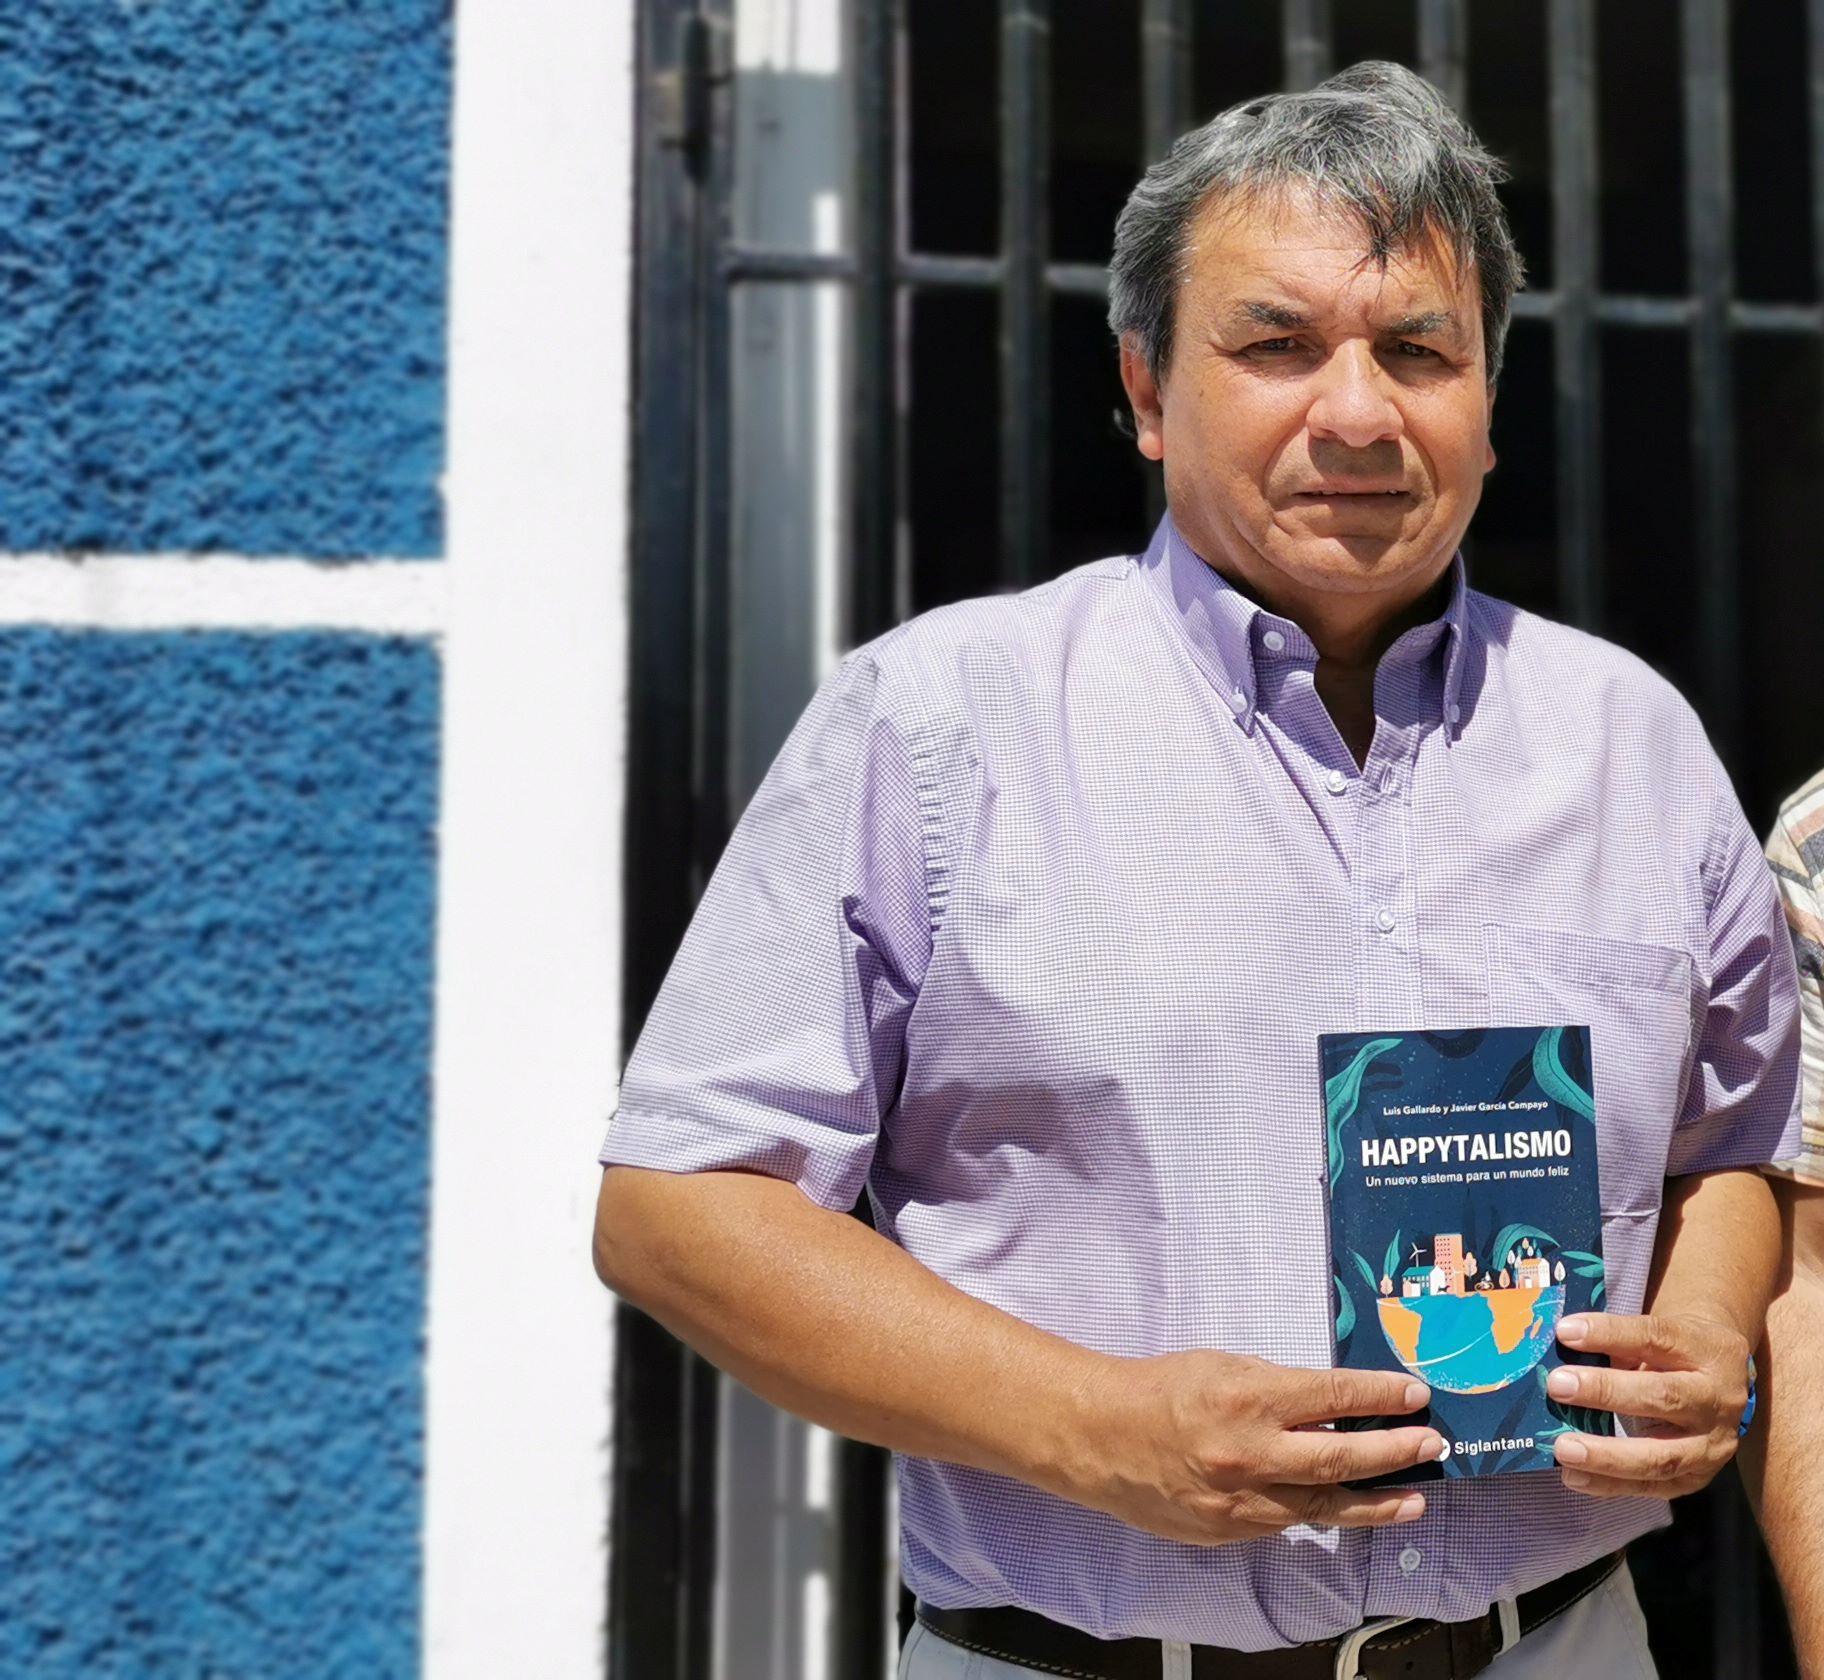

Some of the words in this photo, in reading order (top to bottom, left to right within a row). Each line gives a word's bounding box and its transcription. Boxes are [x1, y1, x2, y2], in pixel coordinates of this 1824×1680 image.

[1383, 1106, 1401, 1116] Luis
[1402, 1104, 1441, 1115] Gallardo
[1443, 1106, 1449, 1116] y
[1450, 1103, 1477, 1113] Javier
[1478, 1101, 1506, 1112] García
[1508, 1100, 1549, 1112] Campayo
[1360, 1129, 1572, 1167] HAPPYTALISMO
[1365, 1175, 1381, 1187] Un
[1384, 1176, 1418, 1186] nuevo
[1421, 1172, 1463, 1185] sistema
[1466, 1172, 1490, 1186] para
[1493, 1170, 1507, 1181] un
[1509, 1167, 1545, 1179] mundo
[1547, 1165, 1570, 1178] feliz
[1454, 1437, 1534, 1456] Siglantana
